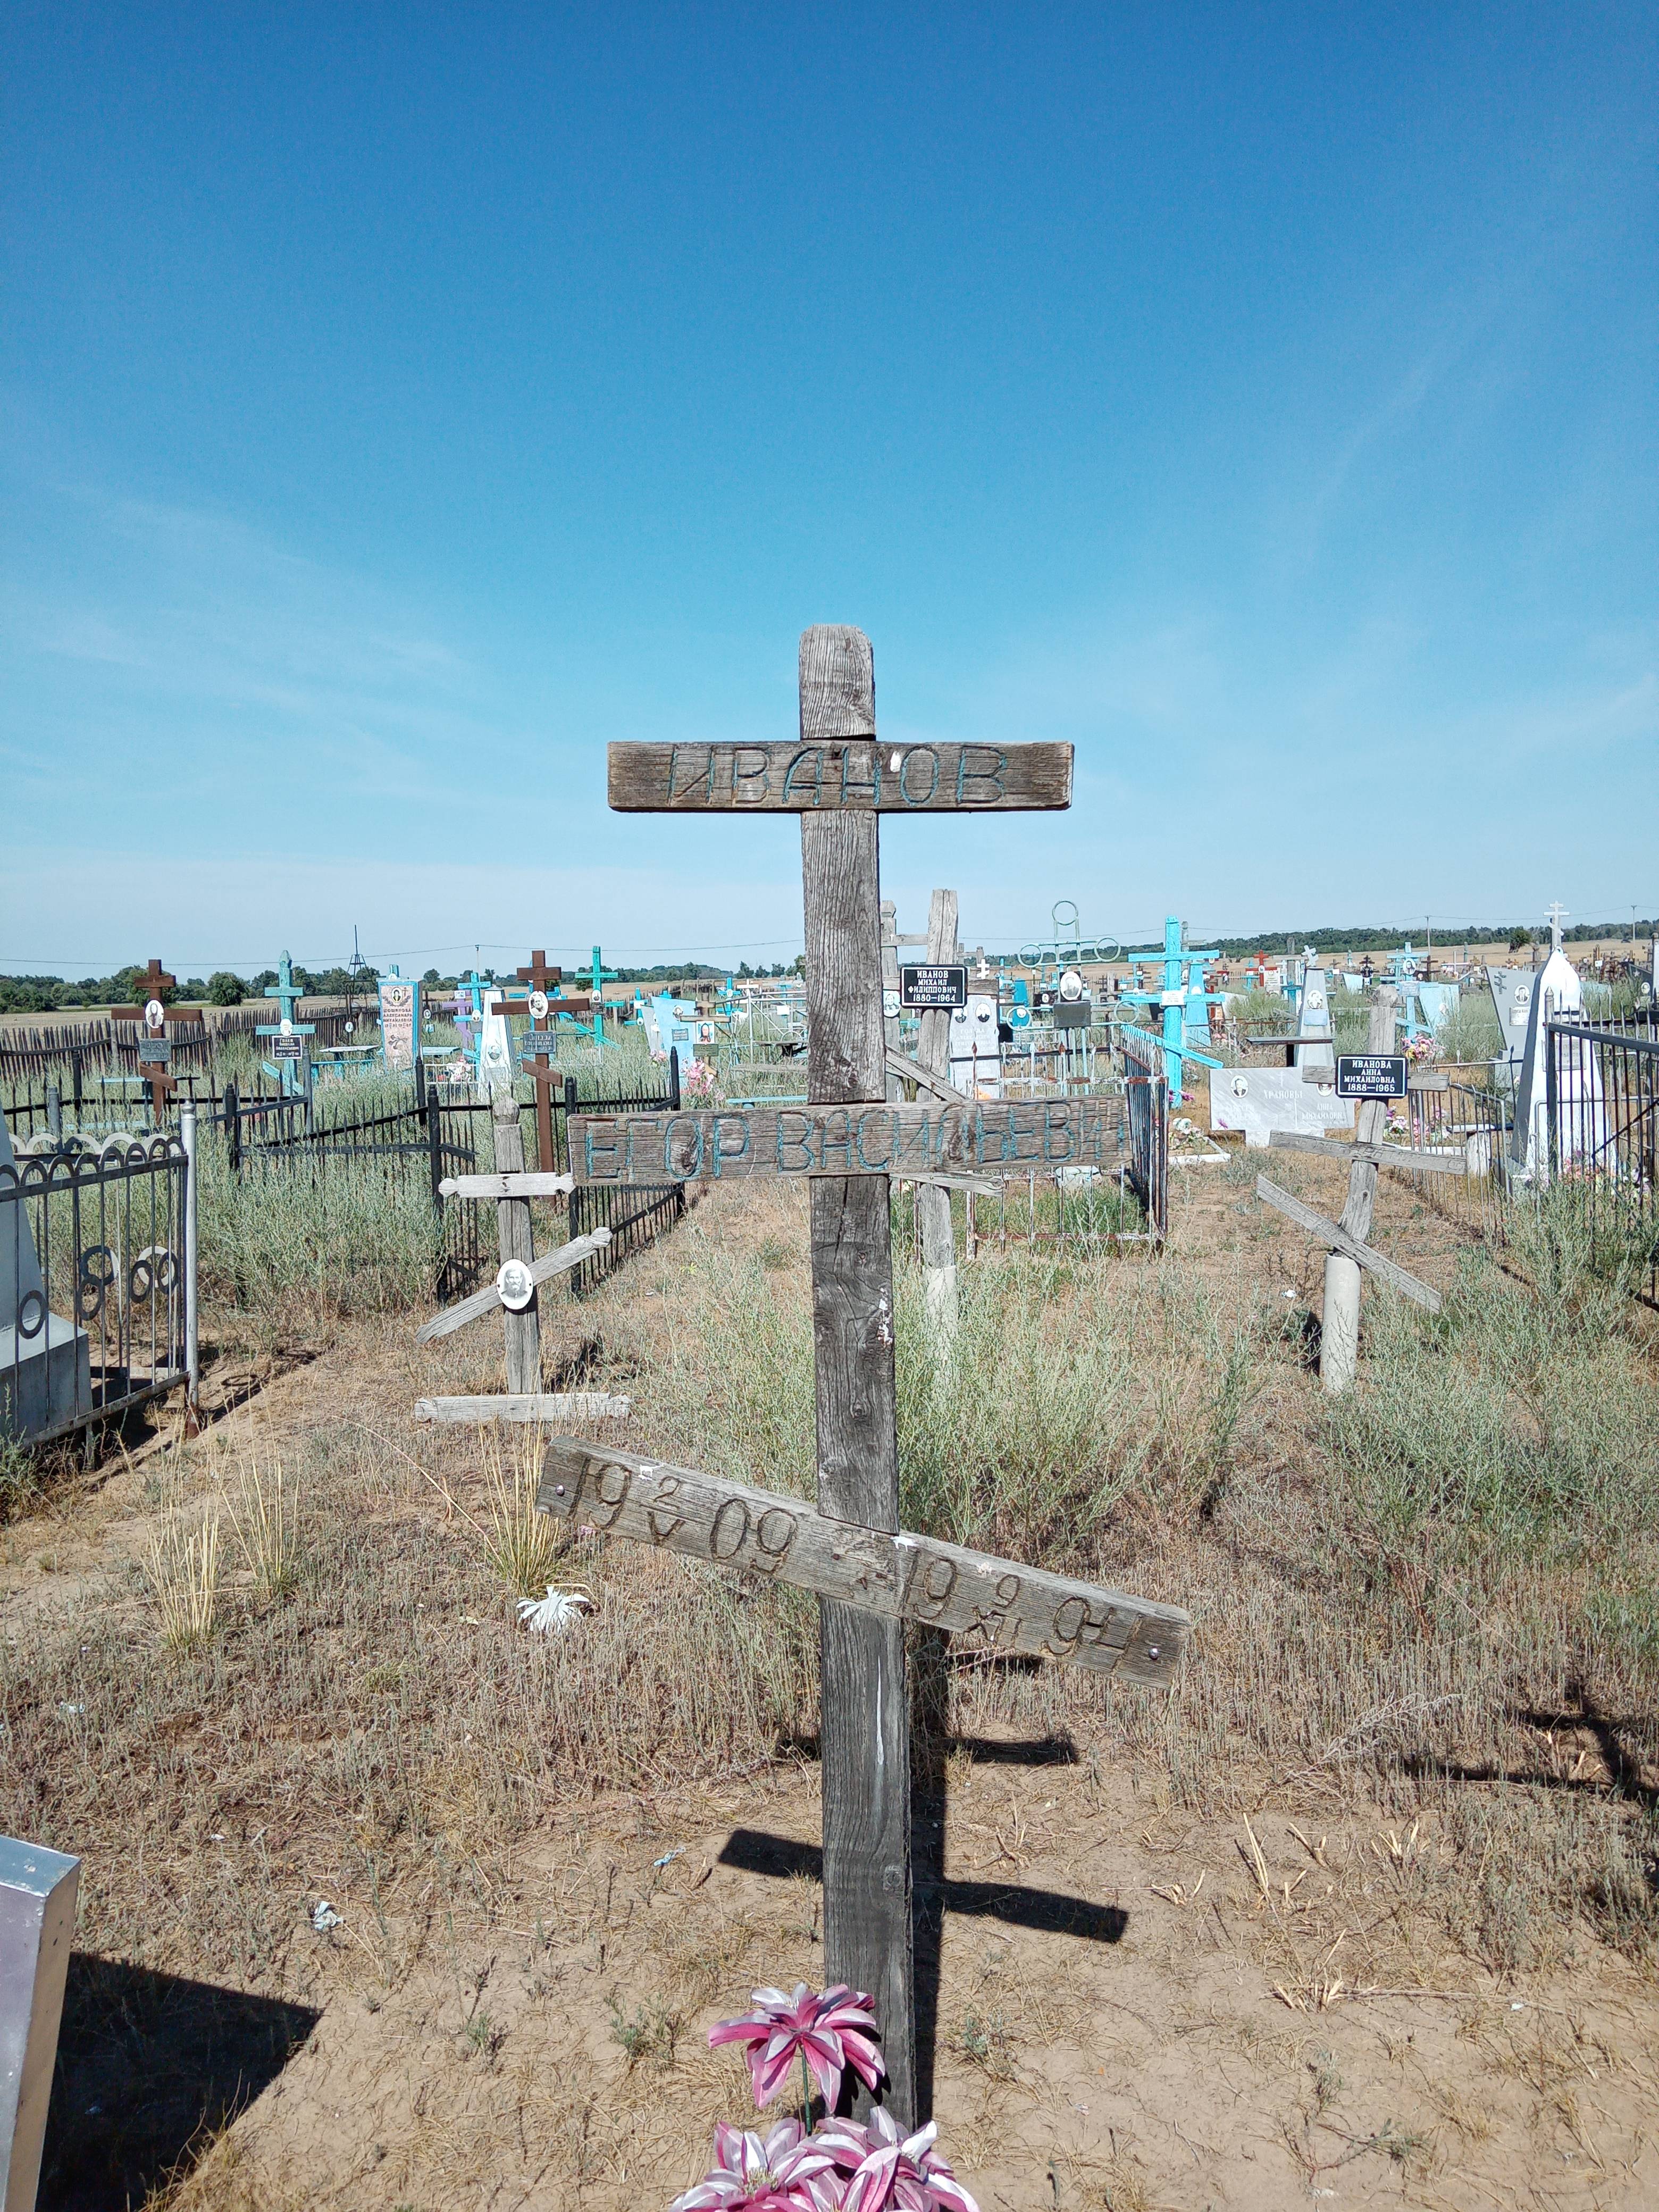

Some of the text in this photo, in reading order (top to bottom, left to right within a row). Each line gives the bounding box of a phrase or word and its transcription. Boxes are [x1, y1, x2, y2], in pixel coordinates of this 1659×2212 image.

[668, 745, 1007, 805] ИВАНОВ
[1352, 1060, 1392, 1069] ИВАНОВА
[585, 1101, 1124, 1181] ЕГОР ВАСИЛЬЕВИЧ
